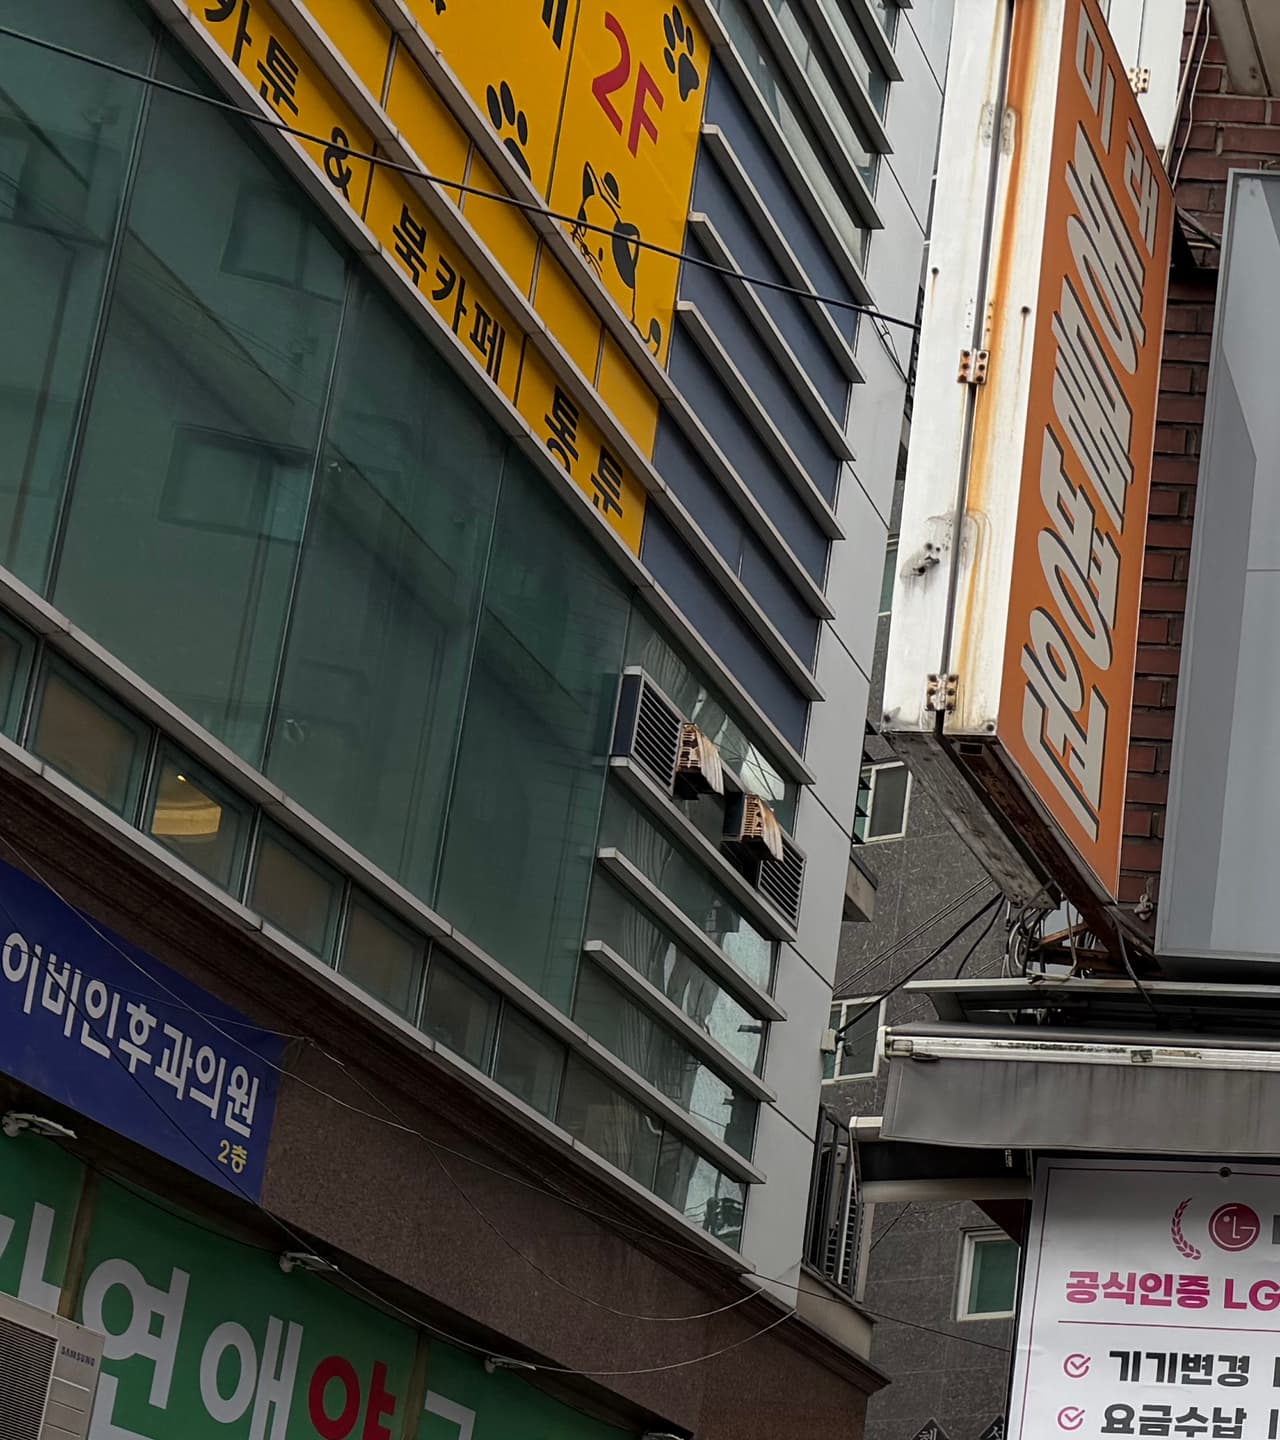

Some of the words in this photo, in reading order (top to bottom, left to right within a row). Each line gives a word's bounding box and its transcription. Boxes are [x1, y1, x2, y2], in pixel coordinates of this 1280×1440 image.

[591, 11, 666, 159] 2F
[392, 203, 506, 384] 북카페
[1021, 119, 1147, 846] 동물병원
[2, 932, 261, 1138] 이비인후과의원
[216, 1138, 248, 1174] 2층
[1065, 1270, 1210, 1306] 공식인증
[1109, 1349, 1250, 1387] 기기변경
[1100, 1402, 1247, 1439] 요금수납
